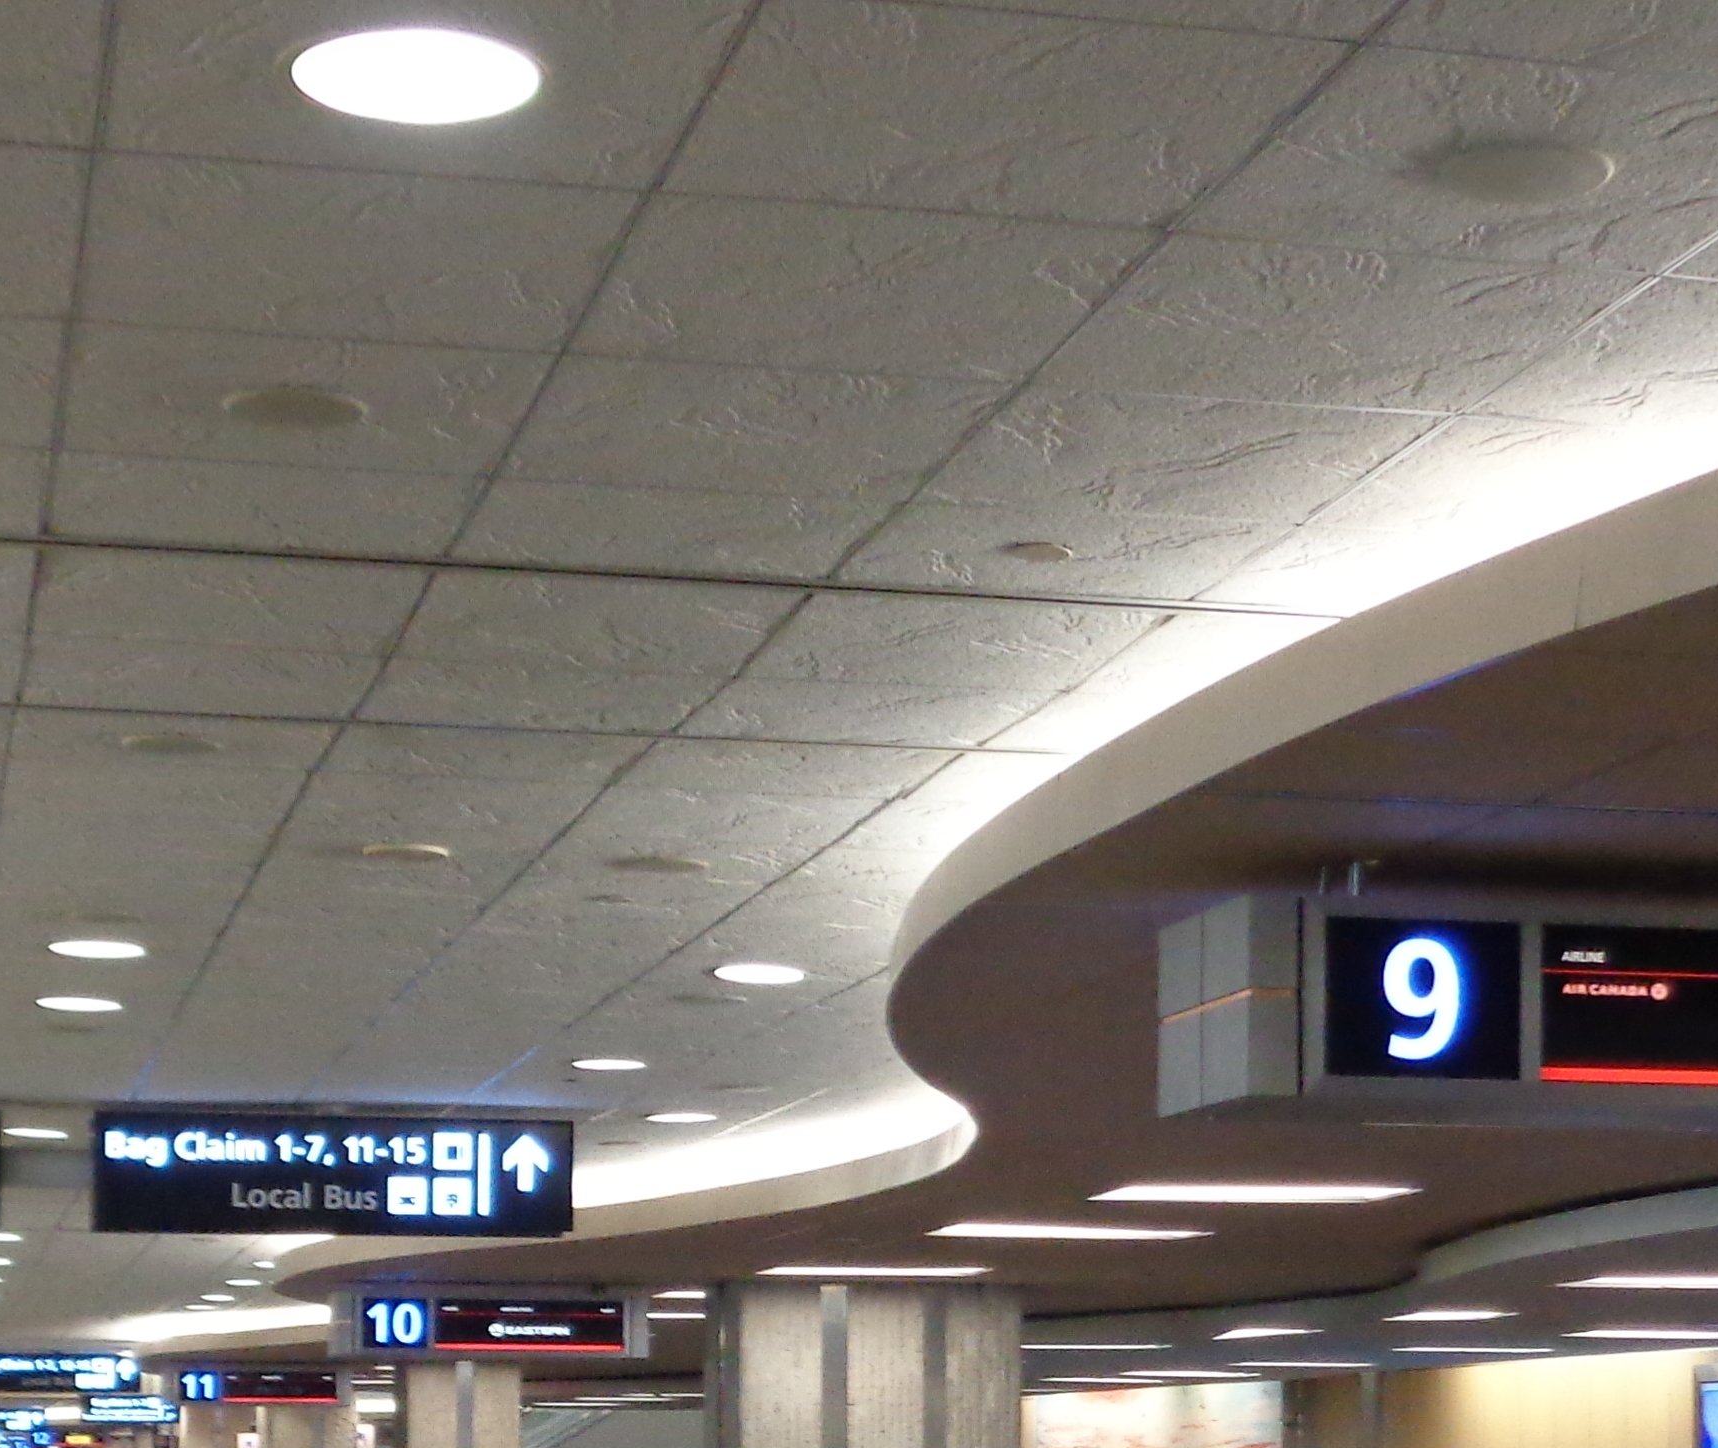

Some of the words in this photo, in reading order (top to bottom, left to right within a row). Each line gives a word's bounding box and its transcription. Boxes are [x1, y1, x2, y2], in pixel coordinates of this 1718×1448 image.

[1561, 951, 1605, 964] AIRLINE
[1383, 937, 1461, 1061] 9
[1562, 982, 1587, 995] AIR
[1589, 983, 1649, 997] CANADA
[104, 1130, 168, 1168] Bag
[173, 1132, 267, 1163] Claim
[274, 1134, 335, 1167] 1-7,
[343, 1136, 427, 1165] 11-15
[231, 1182, 311, 1209] Local
[323, 1185, 378, 1210] Bus
[366, 1302, 423, 1344] 10
[505, 1325, 571, 1337] EASTERN
[181, 1373, 215, 1400] 11
